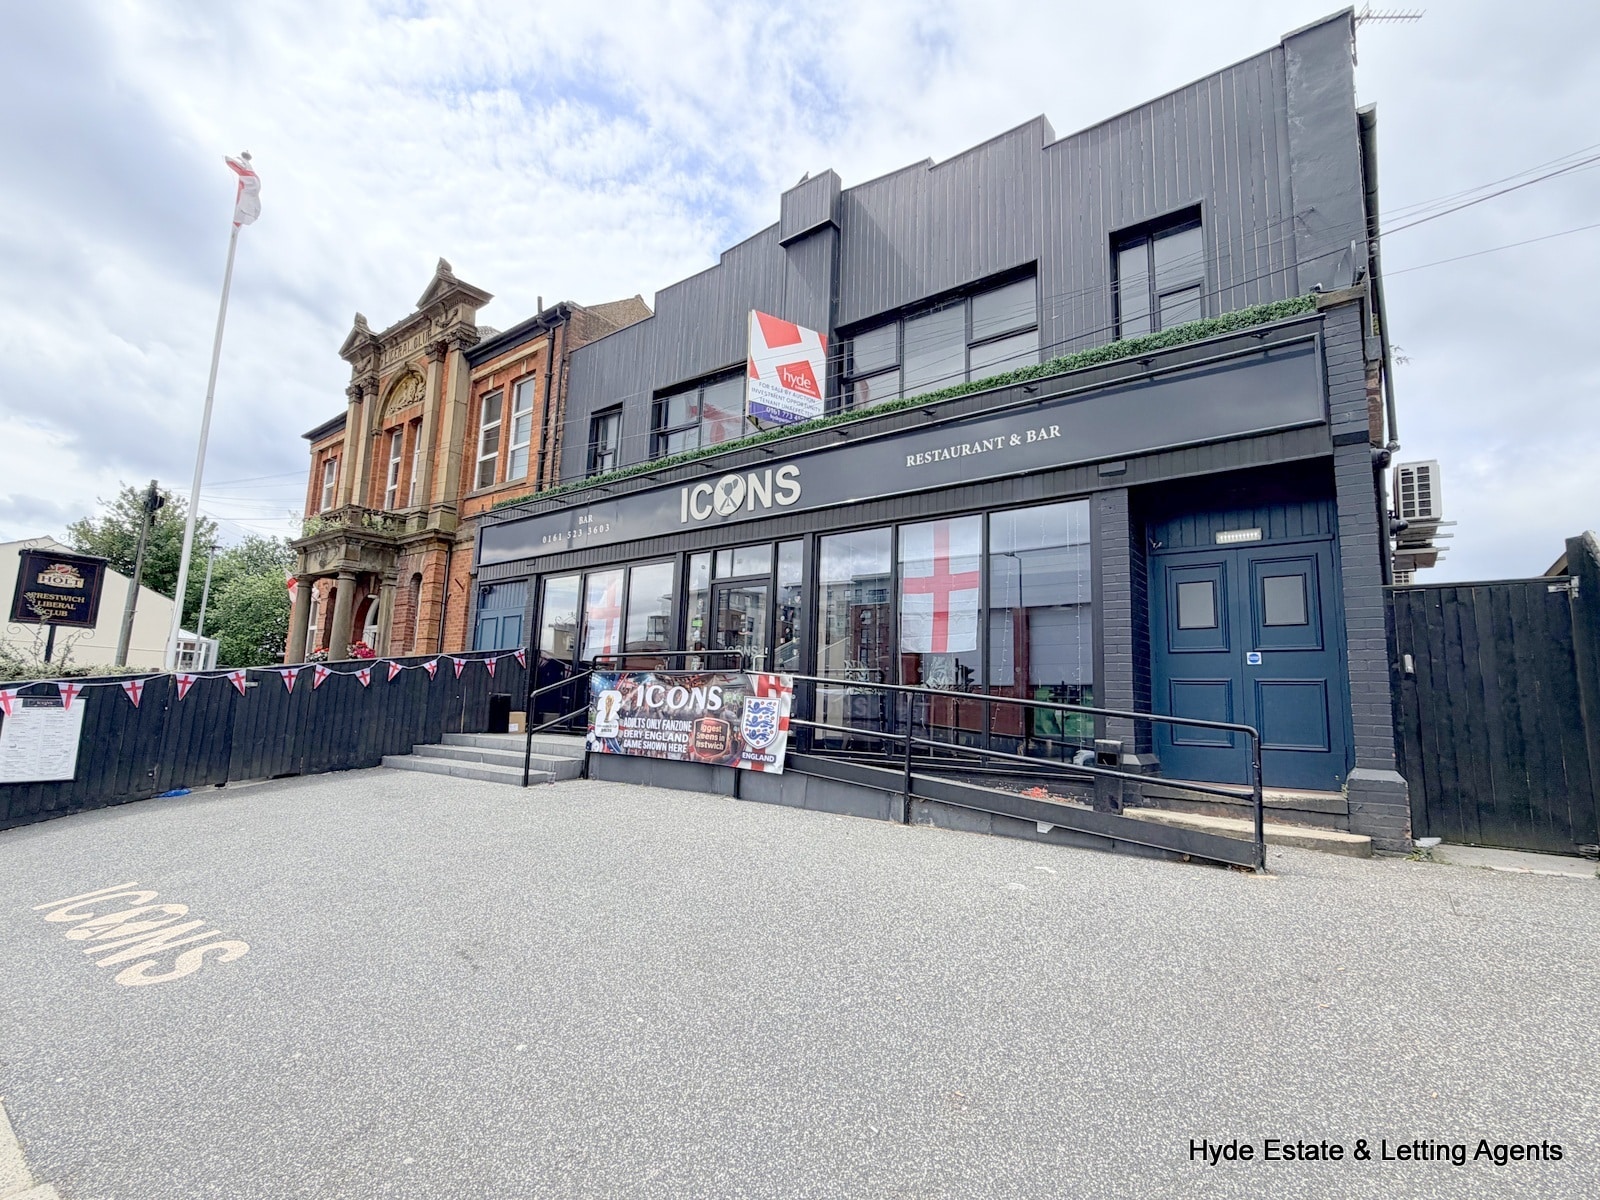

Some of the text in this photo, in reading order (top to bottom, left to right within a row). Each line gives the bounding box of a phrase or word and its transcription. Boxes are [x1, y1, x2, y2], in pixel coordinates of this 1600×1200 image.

[783, 367, 812, 389] hyde
[758, 381, 770, 389] FOR
[792, 391, 817, 403] AUCTION
[751, 387, 786, 401] INVESTMENT
[786, 398, 821, 413] OPPORTUNITY
[758, 397, 781, 407] TENANT
[905, 424, 1062, 467] RESTAURANT & BAR
[680, 464, 801, 524] ICONS
[578, 514, 593, 525] BAR
[542, 523, 610, 543] 0161 523 3603
[41, 575, 81, 586] HOLT
[37, 600, 76, 610] LIBERAL
[45, 609, 68, 617] CLUB
[636, 684, 723, 711] ICONS
[646, 718, 662, 730] ONLY
[662, 719, 693, 732] FANZONE
[645, 730, 689, 743] ENGLAND
[718, 734, 725, 742] in
[643, 741, 667, 752] SHOWN
[668, 743, 688, 753] HERE
[742, 752, 775, 762] ENGLAND
[32, 881, 250, 987] ICONS
